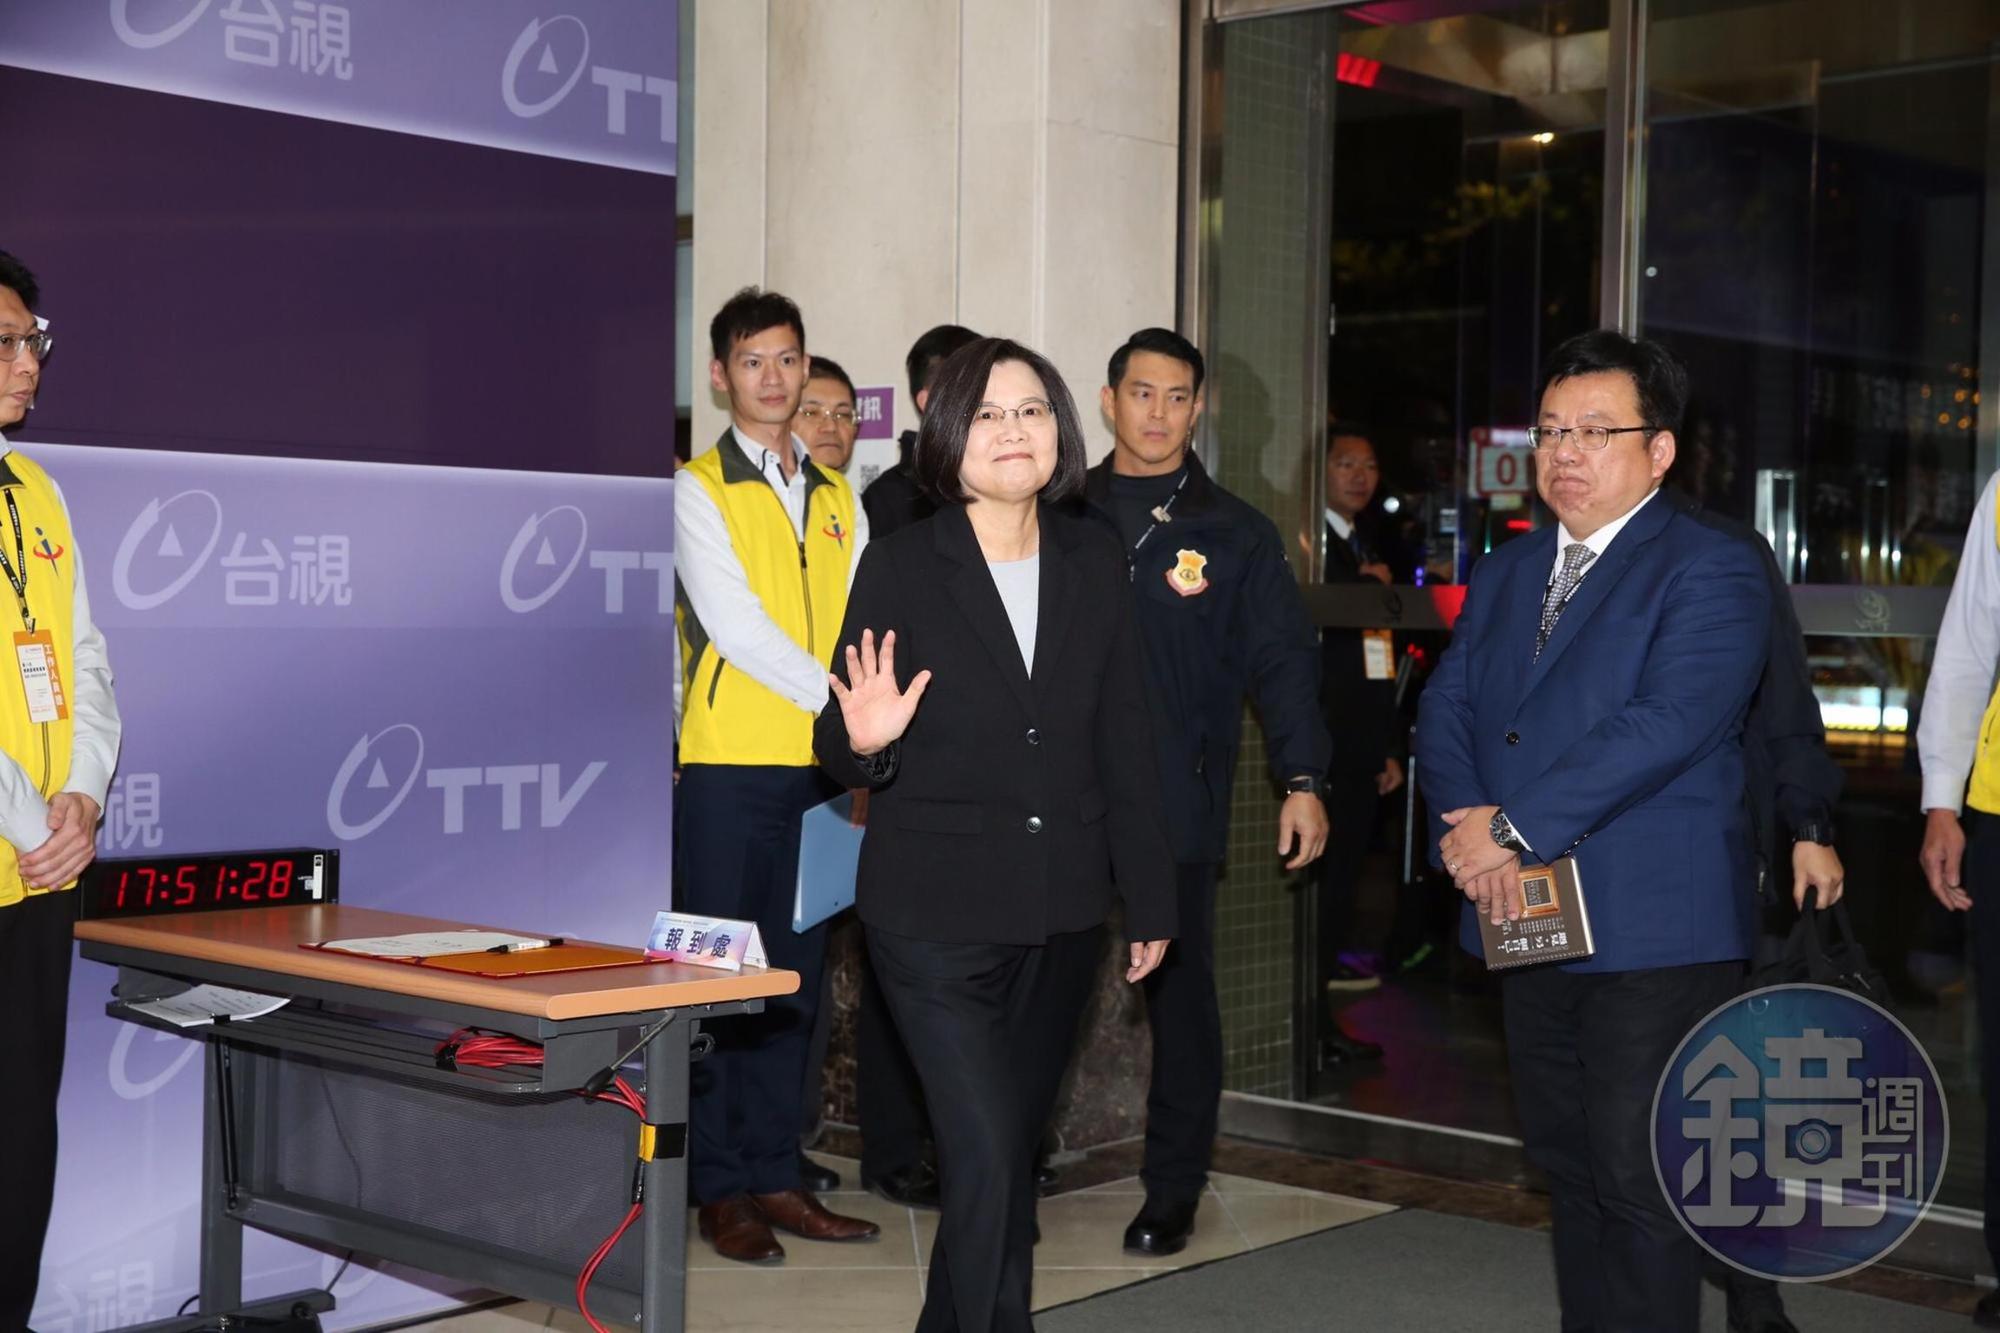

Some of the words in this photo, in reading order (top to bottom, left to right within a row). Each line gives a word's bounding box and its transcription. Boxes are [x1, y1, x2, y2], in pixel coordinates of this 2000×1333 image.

[219, 0, 354, 81] 台視
[219, 531, 353, 606] 台視
[425, 761, 609, 834] TTV
[116, 859, 294, 908] 17:51:28
[664, 927, 732, 958] 報到處
